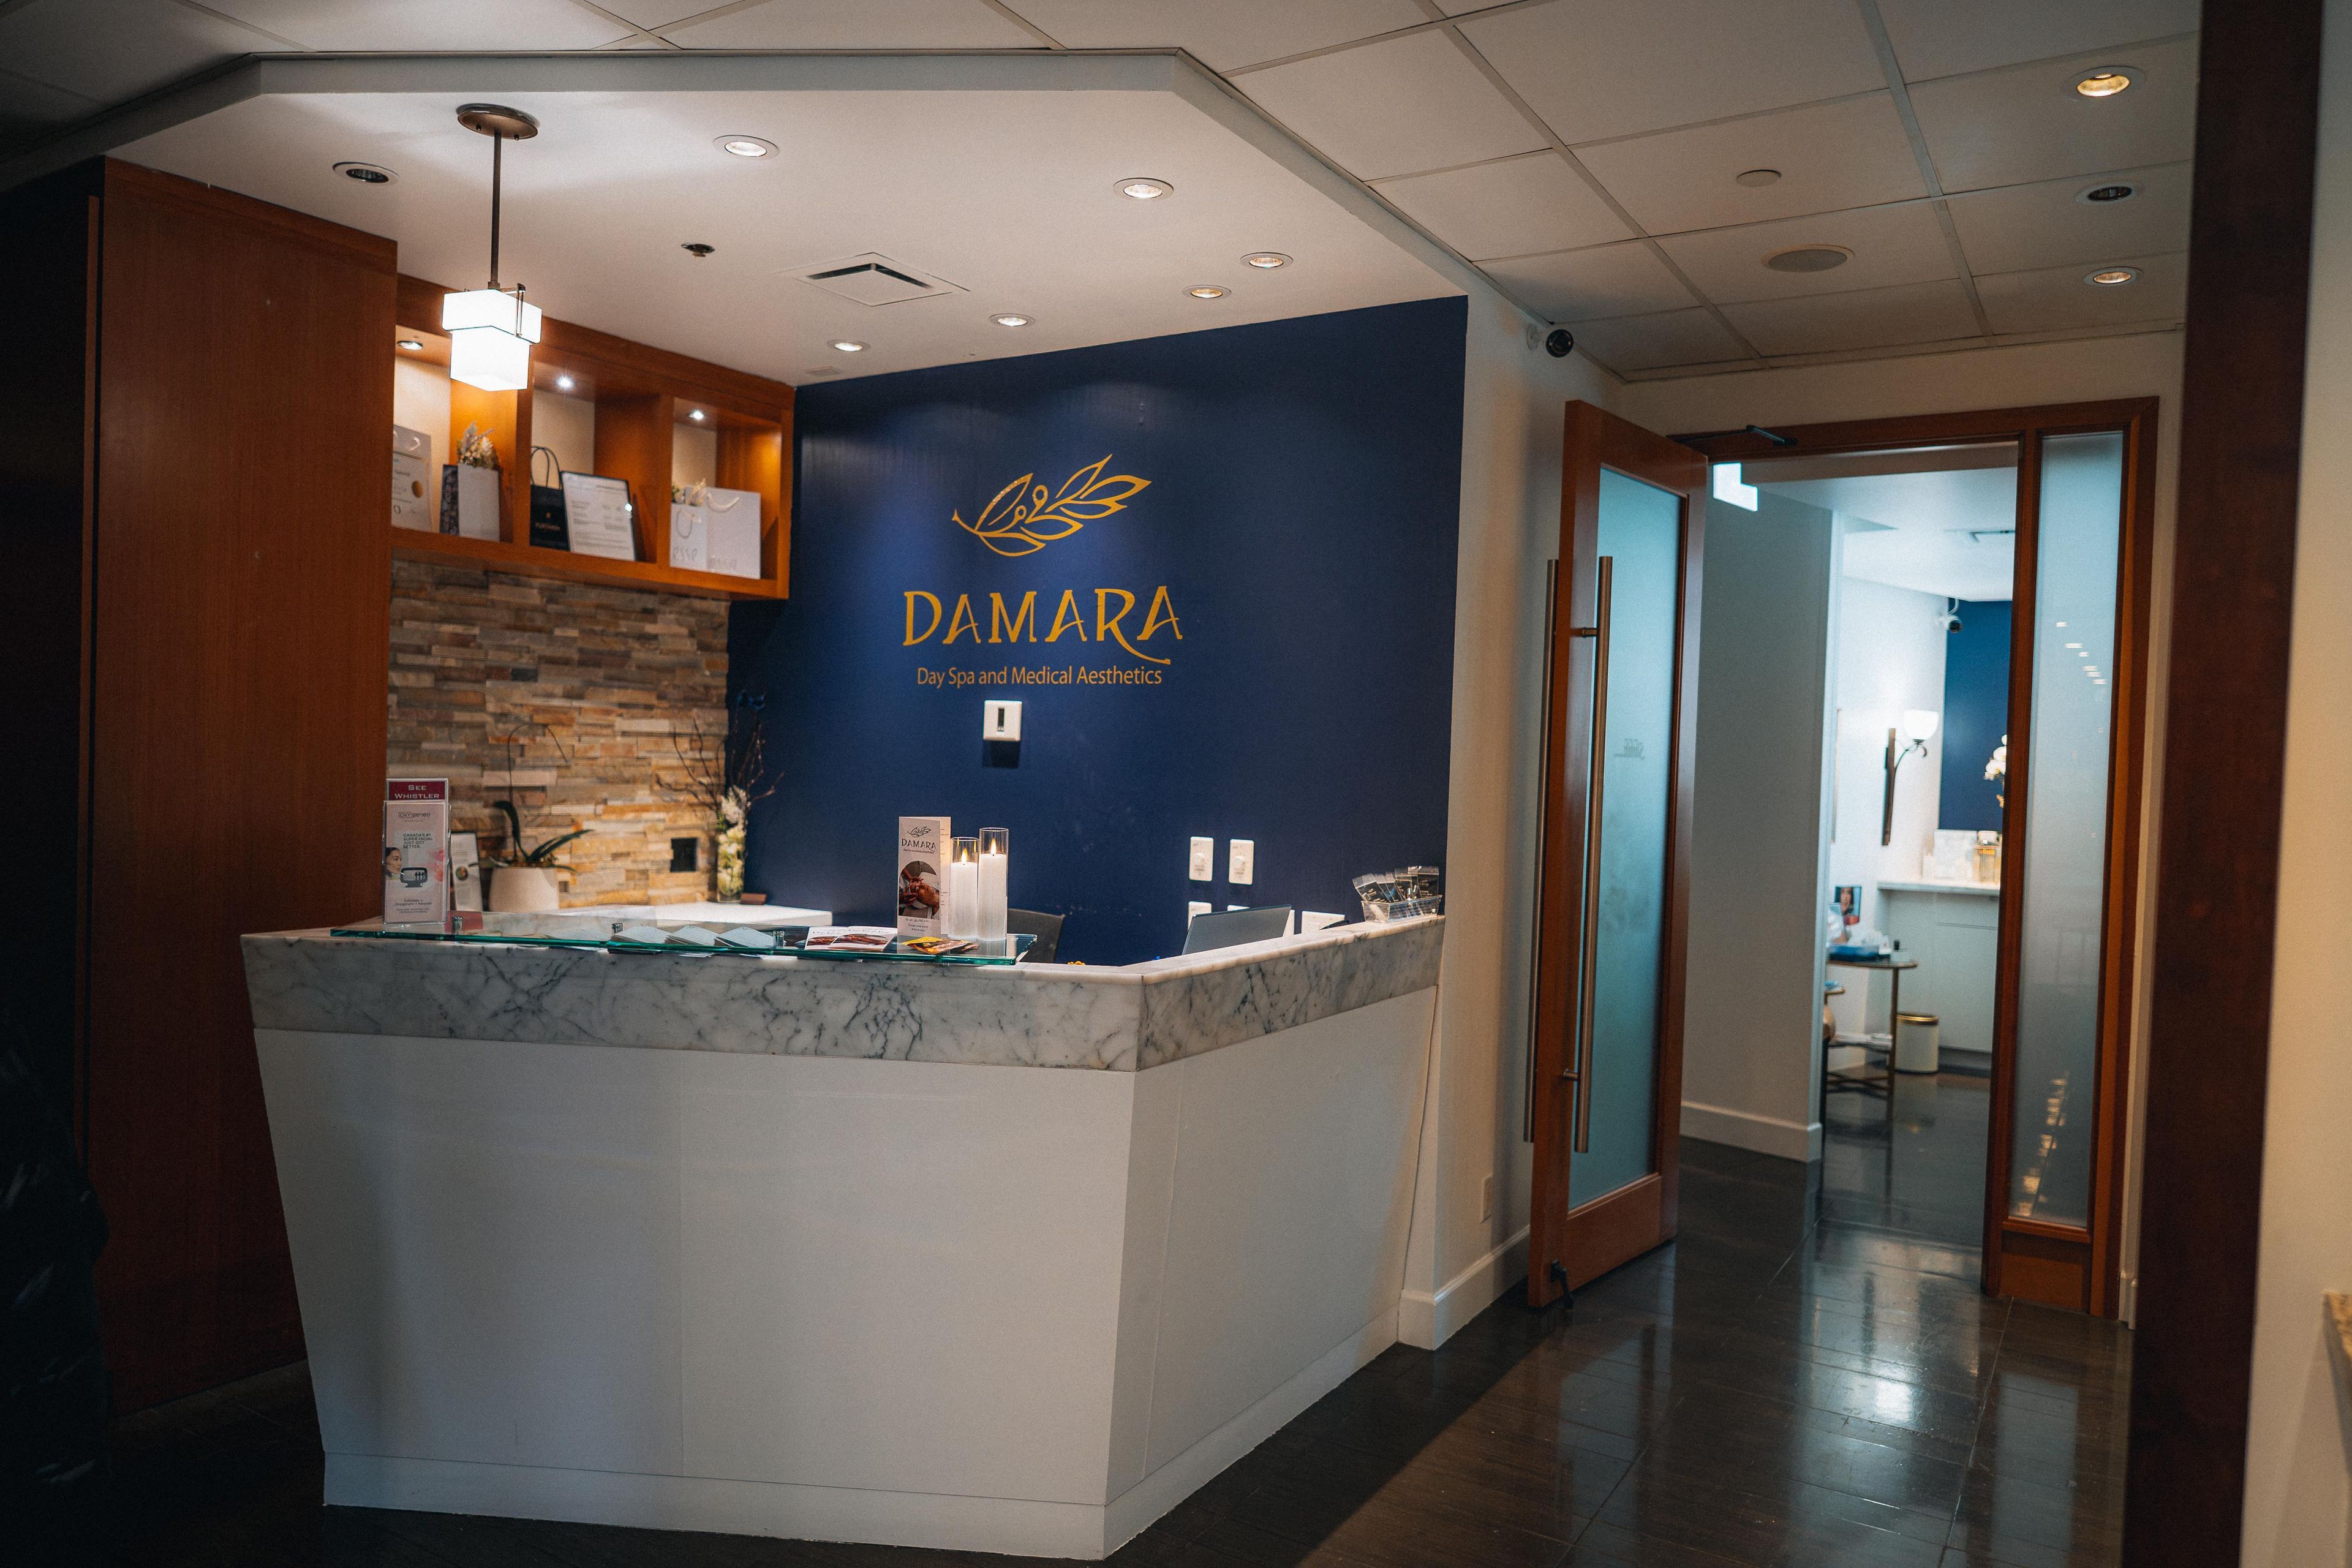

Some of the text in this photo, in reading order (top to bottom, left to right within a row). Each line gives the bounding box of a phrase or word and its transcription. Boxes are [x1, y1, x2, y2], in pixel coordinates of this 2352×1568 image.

[903, 586, 1183, 665] DAMARA
[917, 666, 1163, 690] Day Spa and Medical Aesthetics
[902, 839, 937, 852] DAMARA
